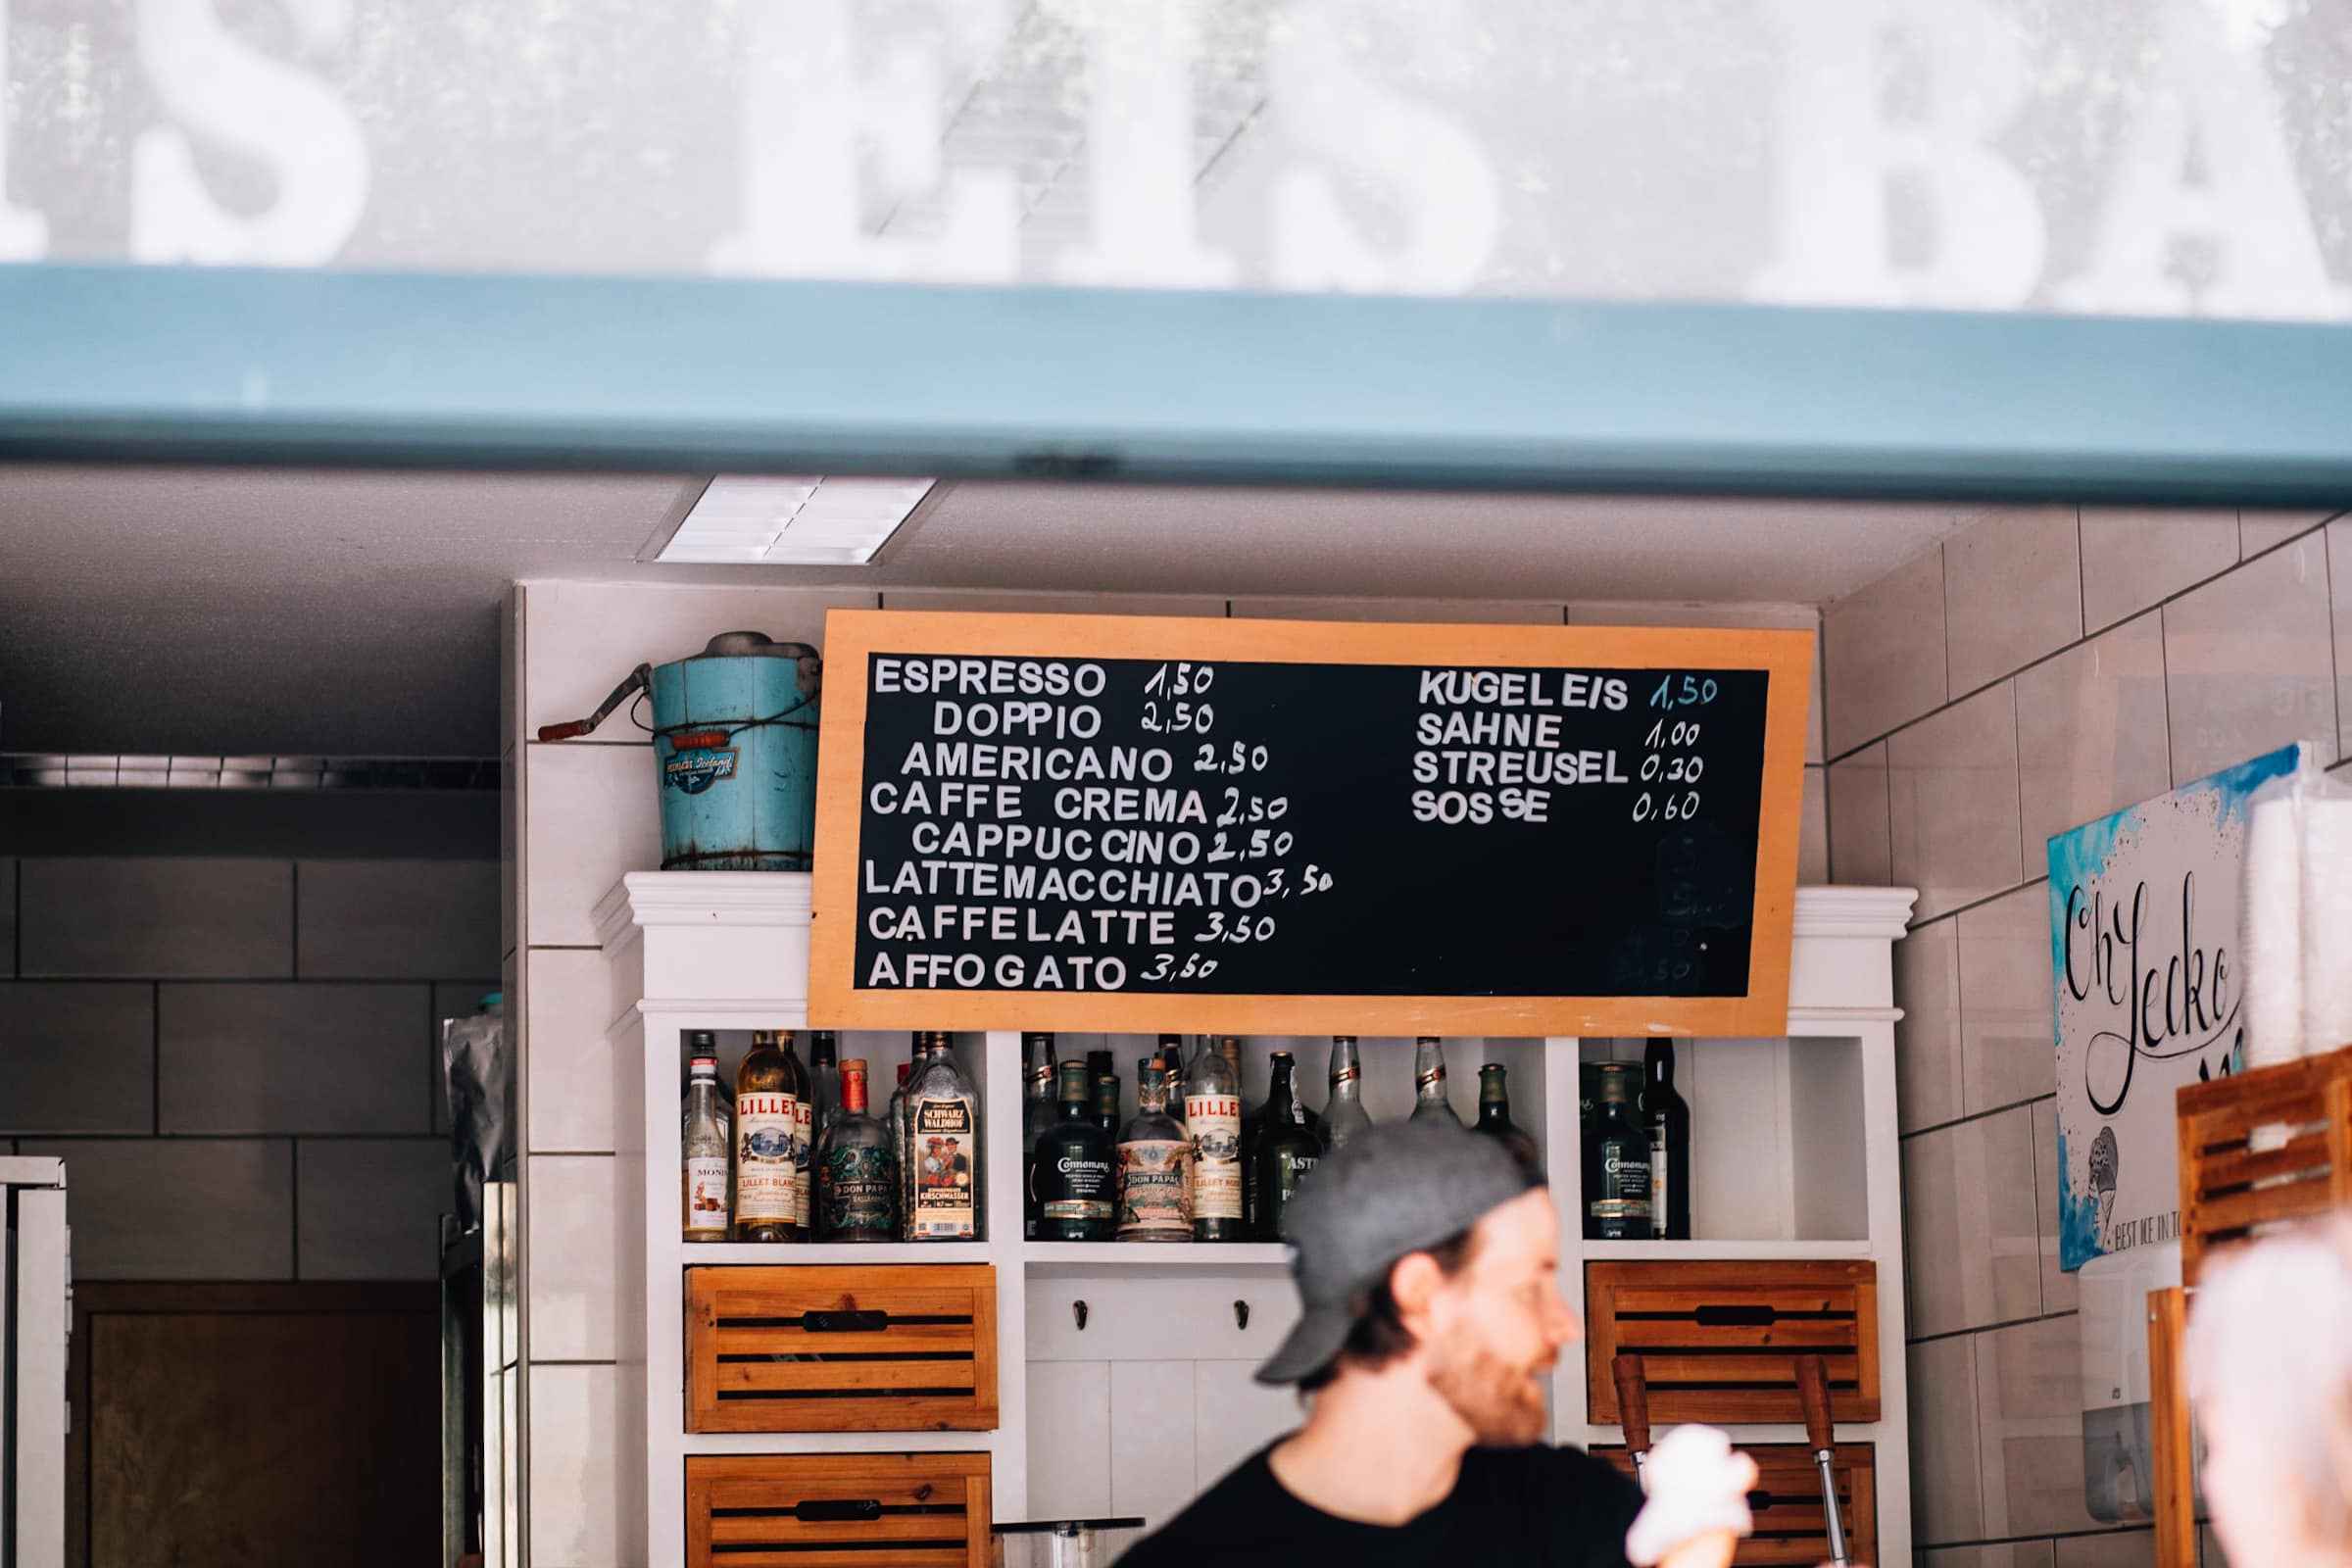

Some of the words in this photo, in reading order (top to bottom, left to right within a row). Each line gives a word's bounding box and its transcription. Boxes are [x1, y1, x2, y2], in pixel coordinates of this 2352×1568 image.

[0, 0, 369, 268] S
[706, 0, 1502, 296] EIS
[876, 659, 1105, 697] ESPRESSO
[1145, 662, 1213, 701] 1,50
[1650, 675, 1717, 710] 1,50
[934, 701, 1101, 739] DOPPIO
[1142, 702, 1213, 733] 2,50
[1417, 711, 1562, 748] SAHNE
[1645, 719, 1699, 748] 1,00
[902, 742, 1172, 782] AMERICANO
[1194, 741, 1267, 774] 2,50
[1413, 751, 1628, 786] STREUSEL
[1641, 755, 1703, 783] 0,30
[870, 781, 1021, 818] CAFFE
[1054, 787, 1207, 823] CREMA
[1217, 787, 1287, 827] 2,50
[1412, 788, 1550, 824] SOSSE
[1633, 792, 1699, 821] 0,60
[912, 821, 1200, 864] CAPPUCCINO
[1207, 829, 1293, 862] 2,50
[1195, 912, 1275, 943] 3,50
[2065, 884, 2127, 1006] Oh
[869, 953, 1126, 990] AFFOGATO
[1141, 954, 1218, 981] 3,50
[1131, 1175, 1151, 1184] DON
[2115, 1220, 2137, 1251] BEST
[2140, 1216, 2153, 1246] ICE
[2158, 1212, 2169, 1241] IN
